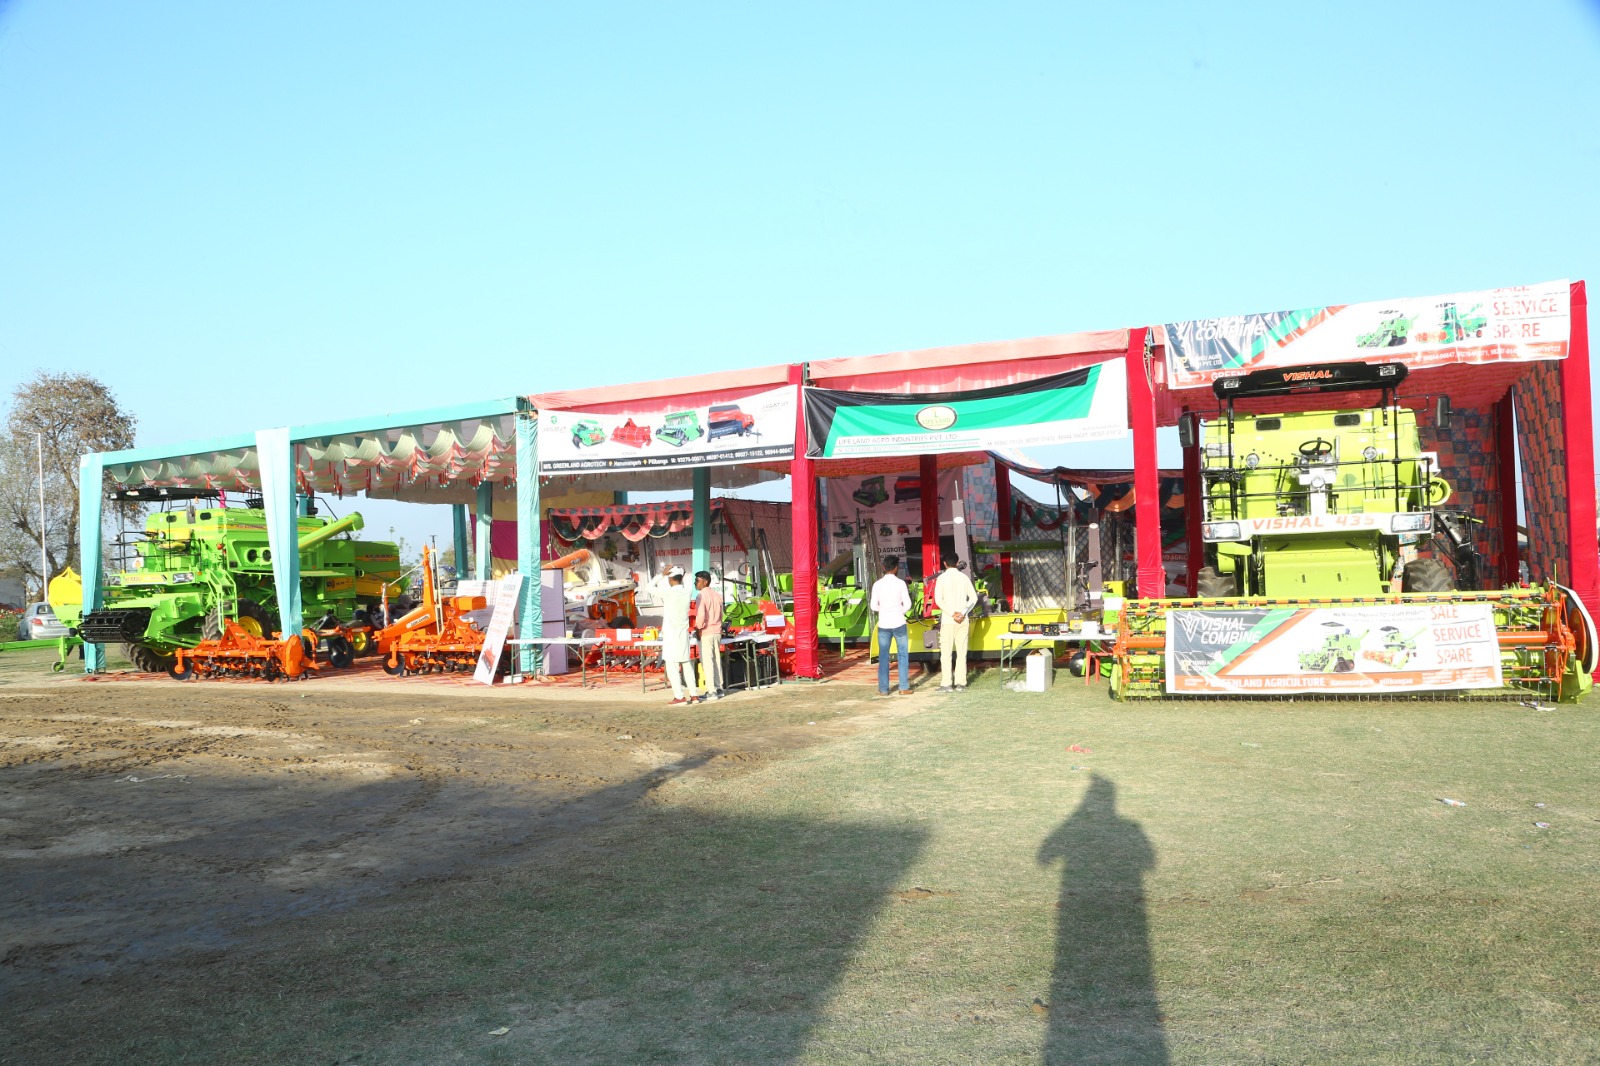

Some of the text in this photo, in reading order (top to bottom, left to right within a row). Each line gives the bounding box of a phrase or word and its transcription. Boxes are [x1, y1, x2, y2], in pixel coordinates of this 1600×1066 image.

[1493, 298, 1557, 316] SERVICE
[1493, 322, 1540, 338] SPARE
[1283, 370, 1333, 381] VISHAL
[891, 435, 928, 443] INDUSTRIES
[553, 461, 580, 469] GREENLAND
[580, 460, 606, 468] AGROTECH
[1253, 515, 1375, 530] VISHAL 435
[1431, 605, 1459, 620] SALE
[1200, 617, 1246, 631] VISHAL
[1200, 631, 1262, 644] COMBINE
[1433, 624, 1482, 642] SERVICE
[1437, 648, 1473, 664] SPARE
[1264, 677, 1325, 687] AGRICULTURE
